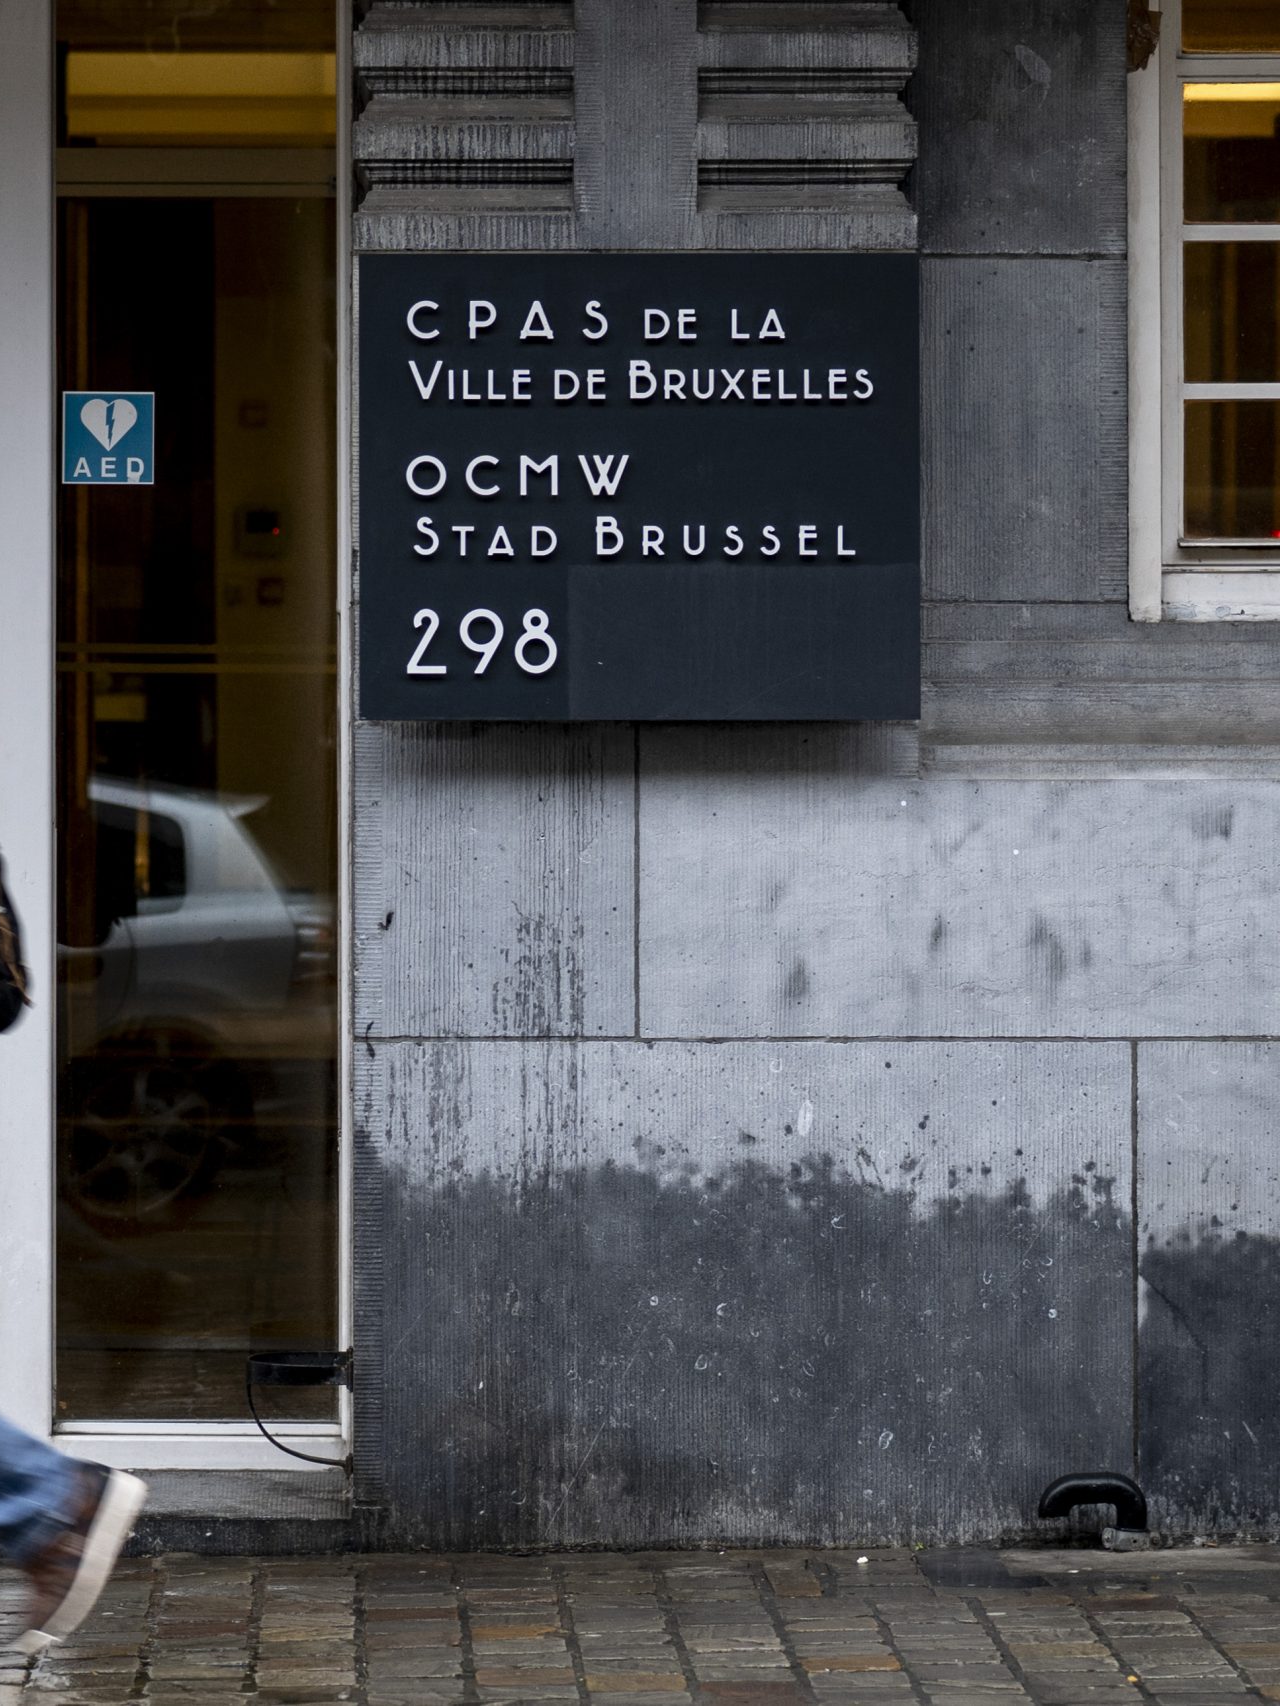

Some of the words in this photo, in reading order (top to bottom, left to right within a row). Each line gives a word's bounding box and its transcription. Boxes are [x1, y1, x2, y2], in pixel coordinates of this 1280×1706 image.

[644, 308, 698, 340] DE
[731, 308, 786, 340] LA
[408, 359, 532, 400] VILLE
[553, 368, 607, 400] DE
[628, 359, 874, 400] BRUXELLES
[73, 457, 145, 478] AED
[405, 454, 630, 496] OCMW
[413, 516, 558, 556] STAD
[595, 515, 857, 556] BRUSSEL
[406, 607, 558, 675] 298
